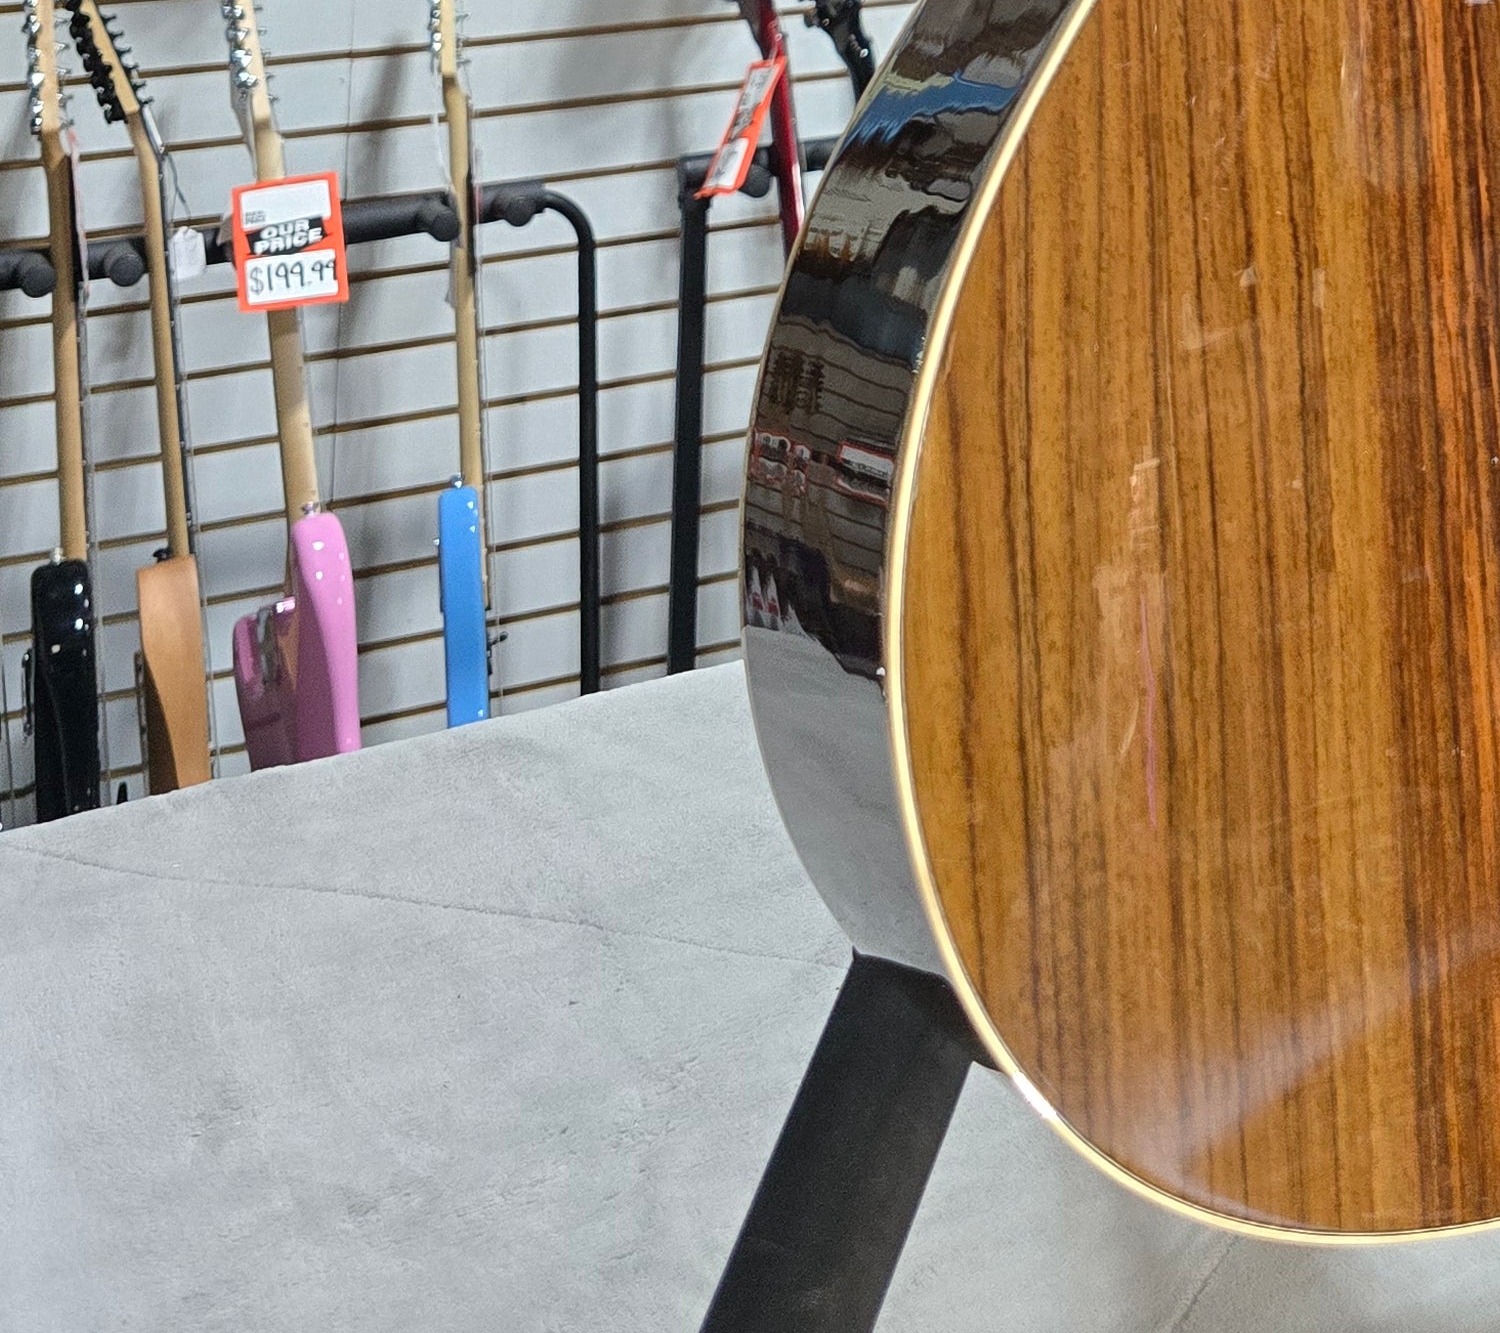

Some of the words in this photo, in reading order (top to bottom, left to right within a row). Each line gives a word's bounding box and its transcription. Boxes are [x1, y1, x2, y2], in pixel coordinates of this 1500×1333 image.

[253, 227, 323, 255] PRICE
[260, 219, 310, 240] OUR
[249, 259, 338, 295] $199.99
